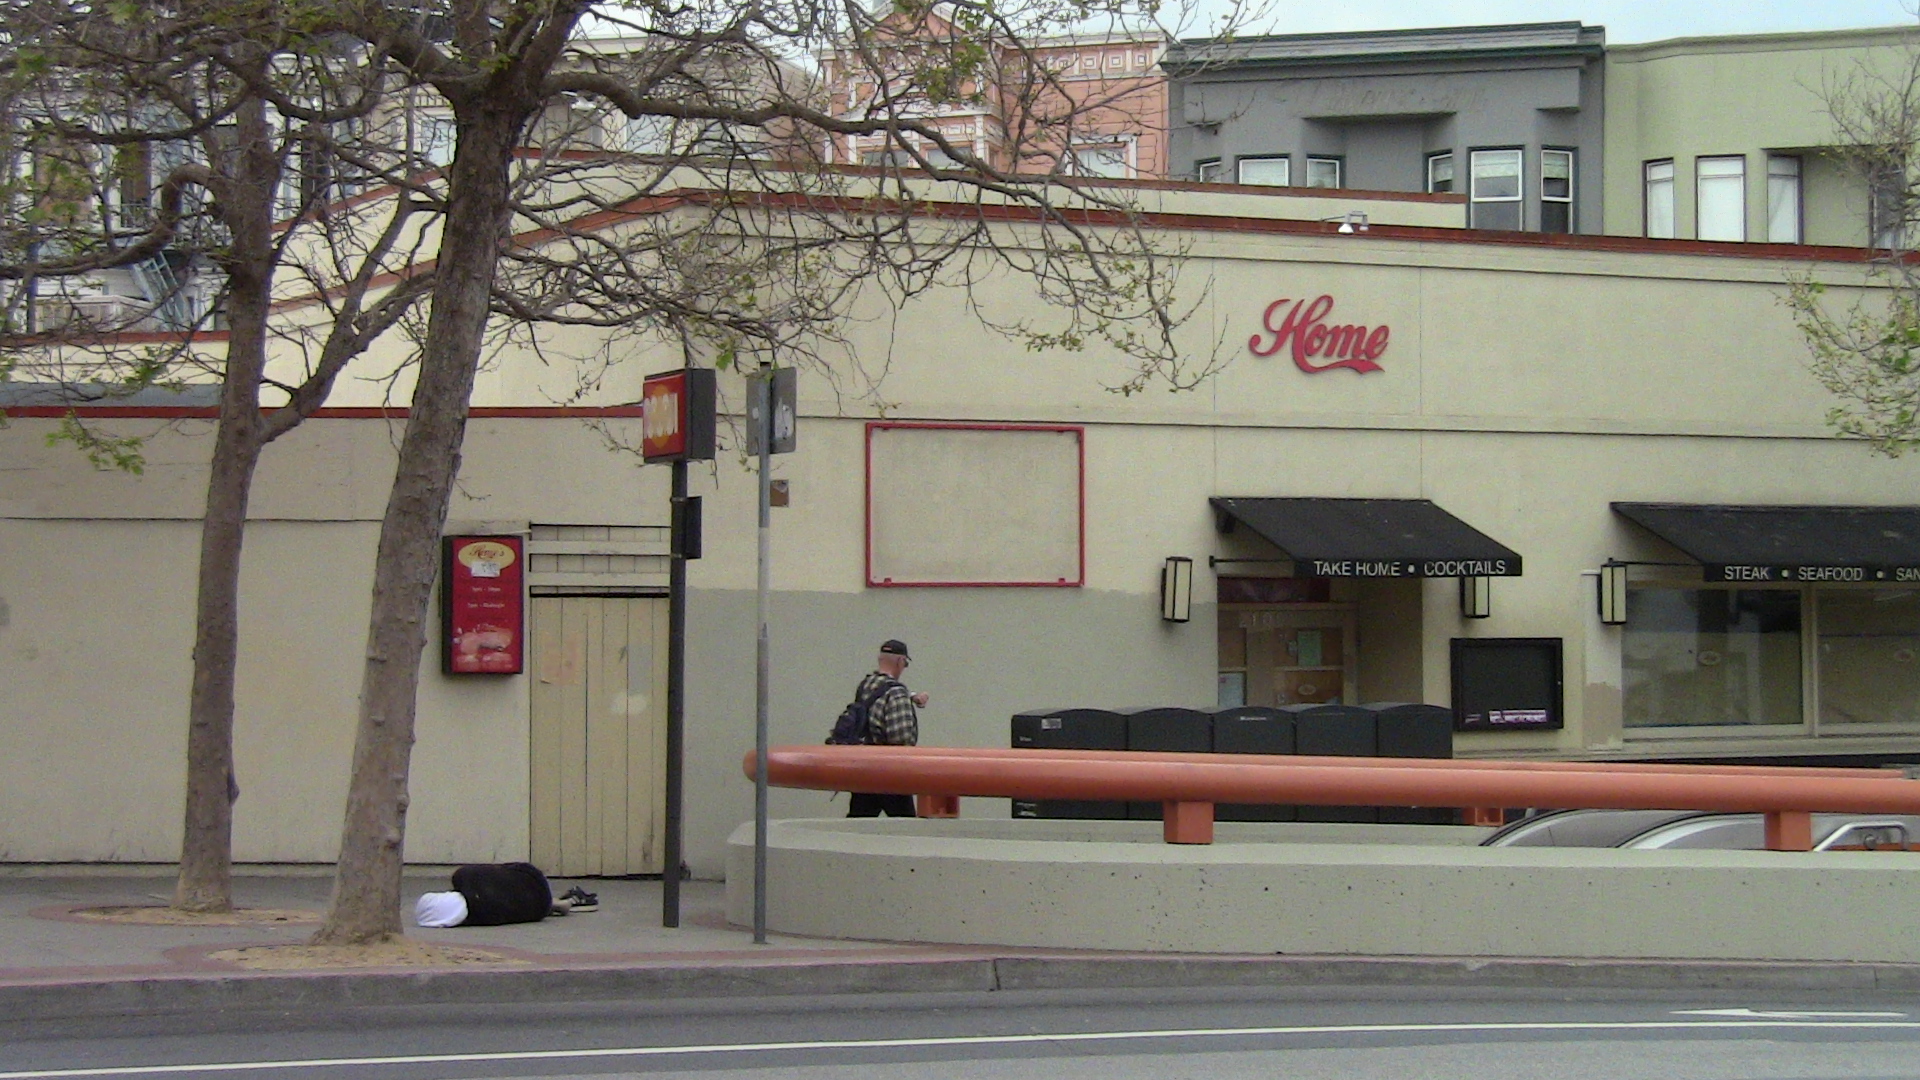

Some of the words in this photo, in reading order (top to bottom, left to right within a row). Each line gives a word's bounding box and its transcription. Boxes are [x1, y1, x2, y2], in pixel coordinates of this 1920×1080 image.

[1248, 294, 1390, 375] Home
[1314, 560, 1351, 576] TAKE
[1355, 561, 1401, 577] HOME
[1424, 559, 1506, 576] COCKTAILS
[1724, 565, 1770, 581] STEAK
[1798, 566, 1864, 582] SEAFOOD
